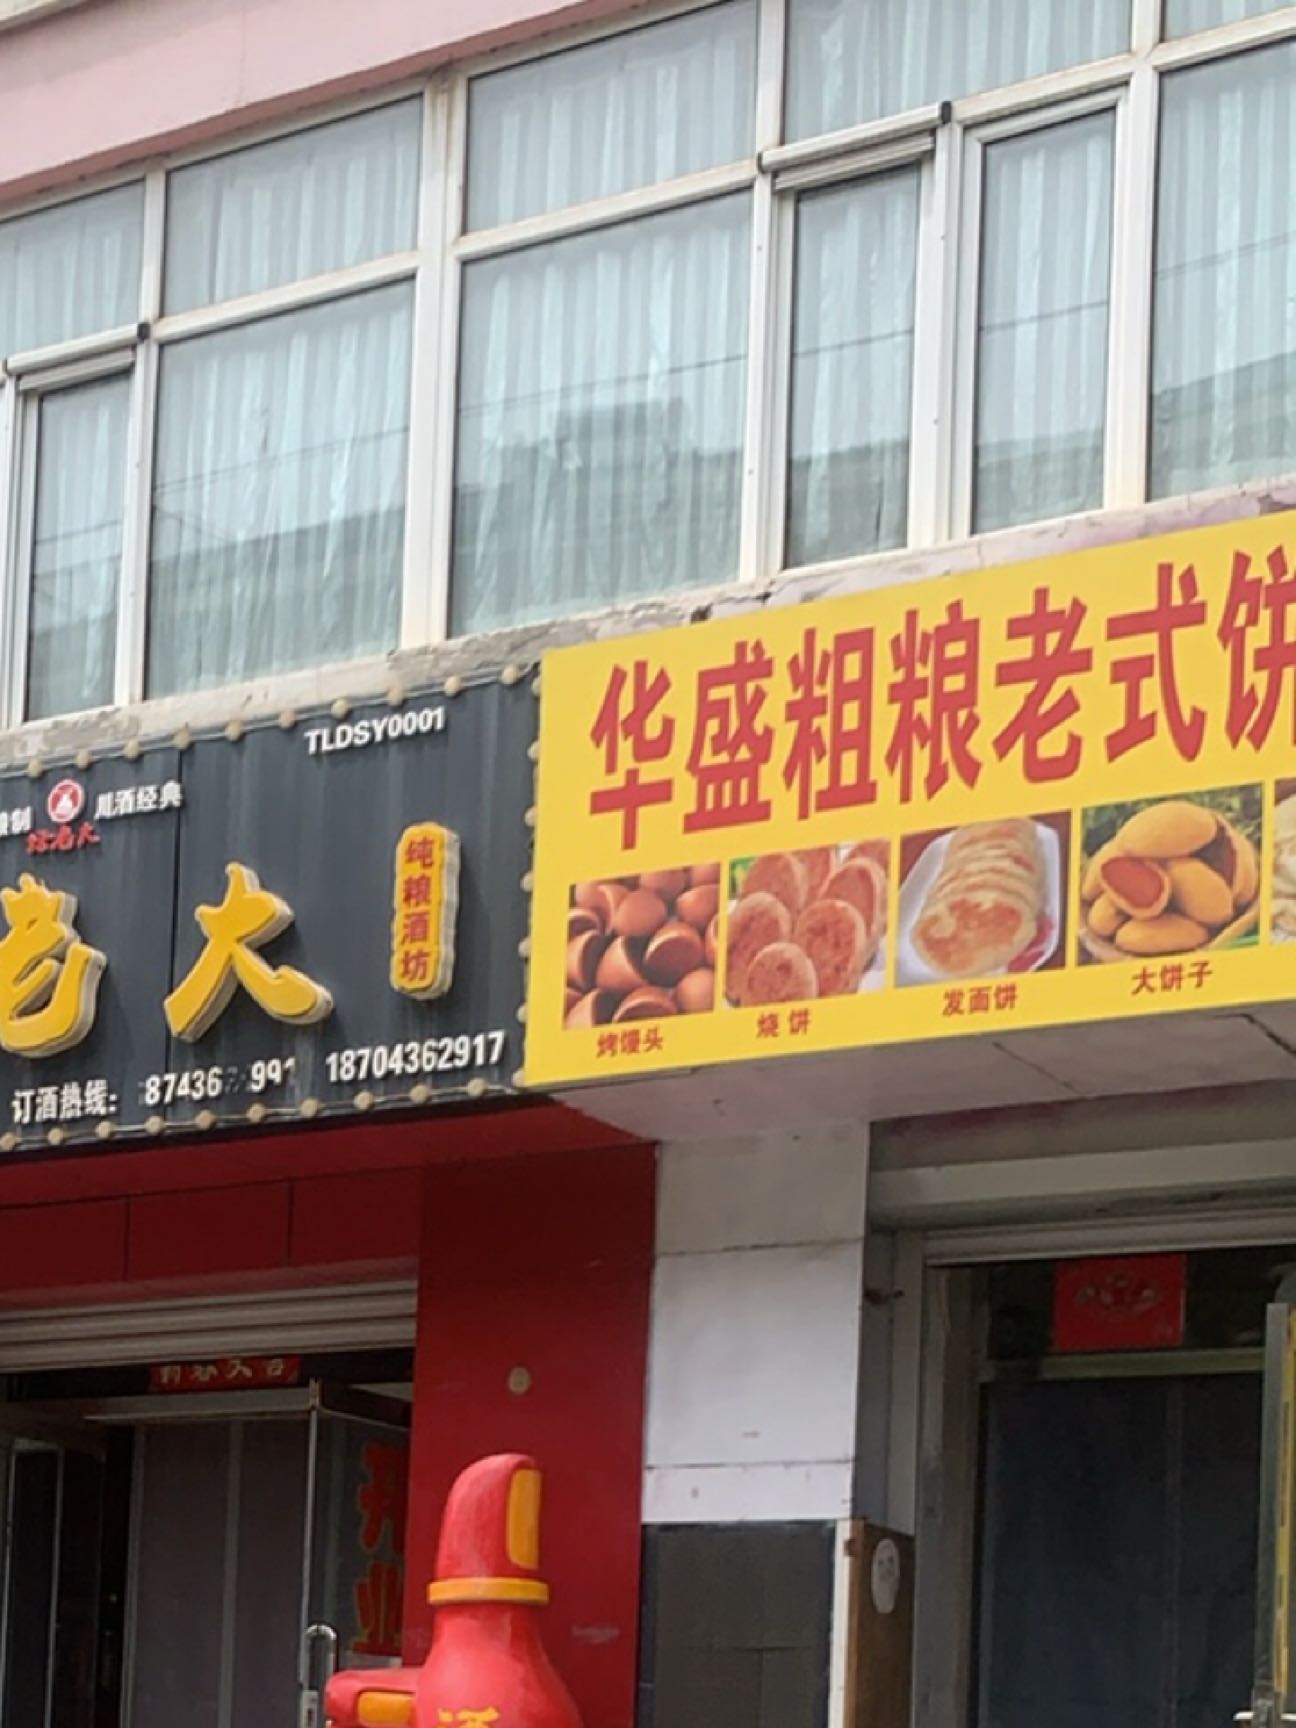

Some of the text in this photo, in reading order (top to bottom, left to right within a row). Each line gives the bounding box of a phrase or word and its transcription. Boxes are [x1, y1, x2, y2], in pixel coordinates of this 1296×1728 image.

[588, 544, 1296, 852] 华盛粗粮老式饼
[304, 706, 446, 756] TLDSY0001
[942, 984, 1019, 1017] 发面饼
[1130, 964, 1214, 996] 大饼子
[326, 1030, 506, 1082] 18704362917
[596, 1028, 664, 1059] 烤馒头
